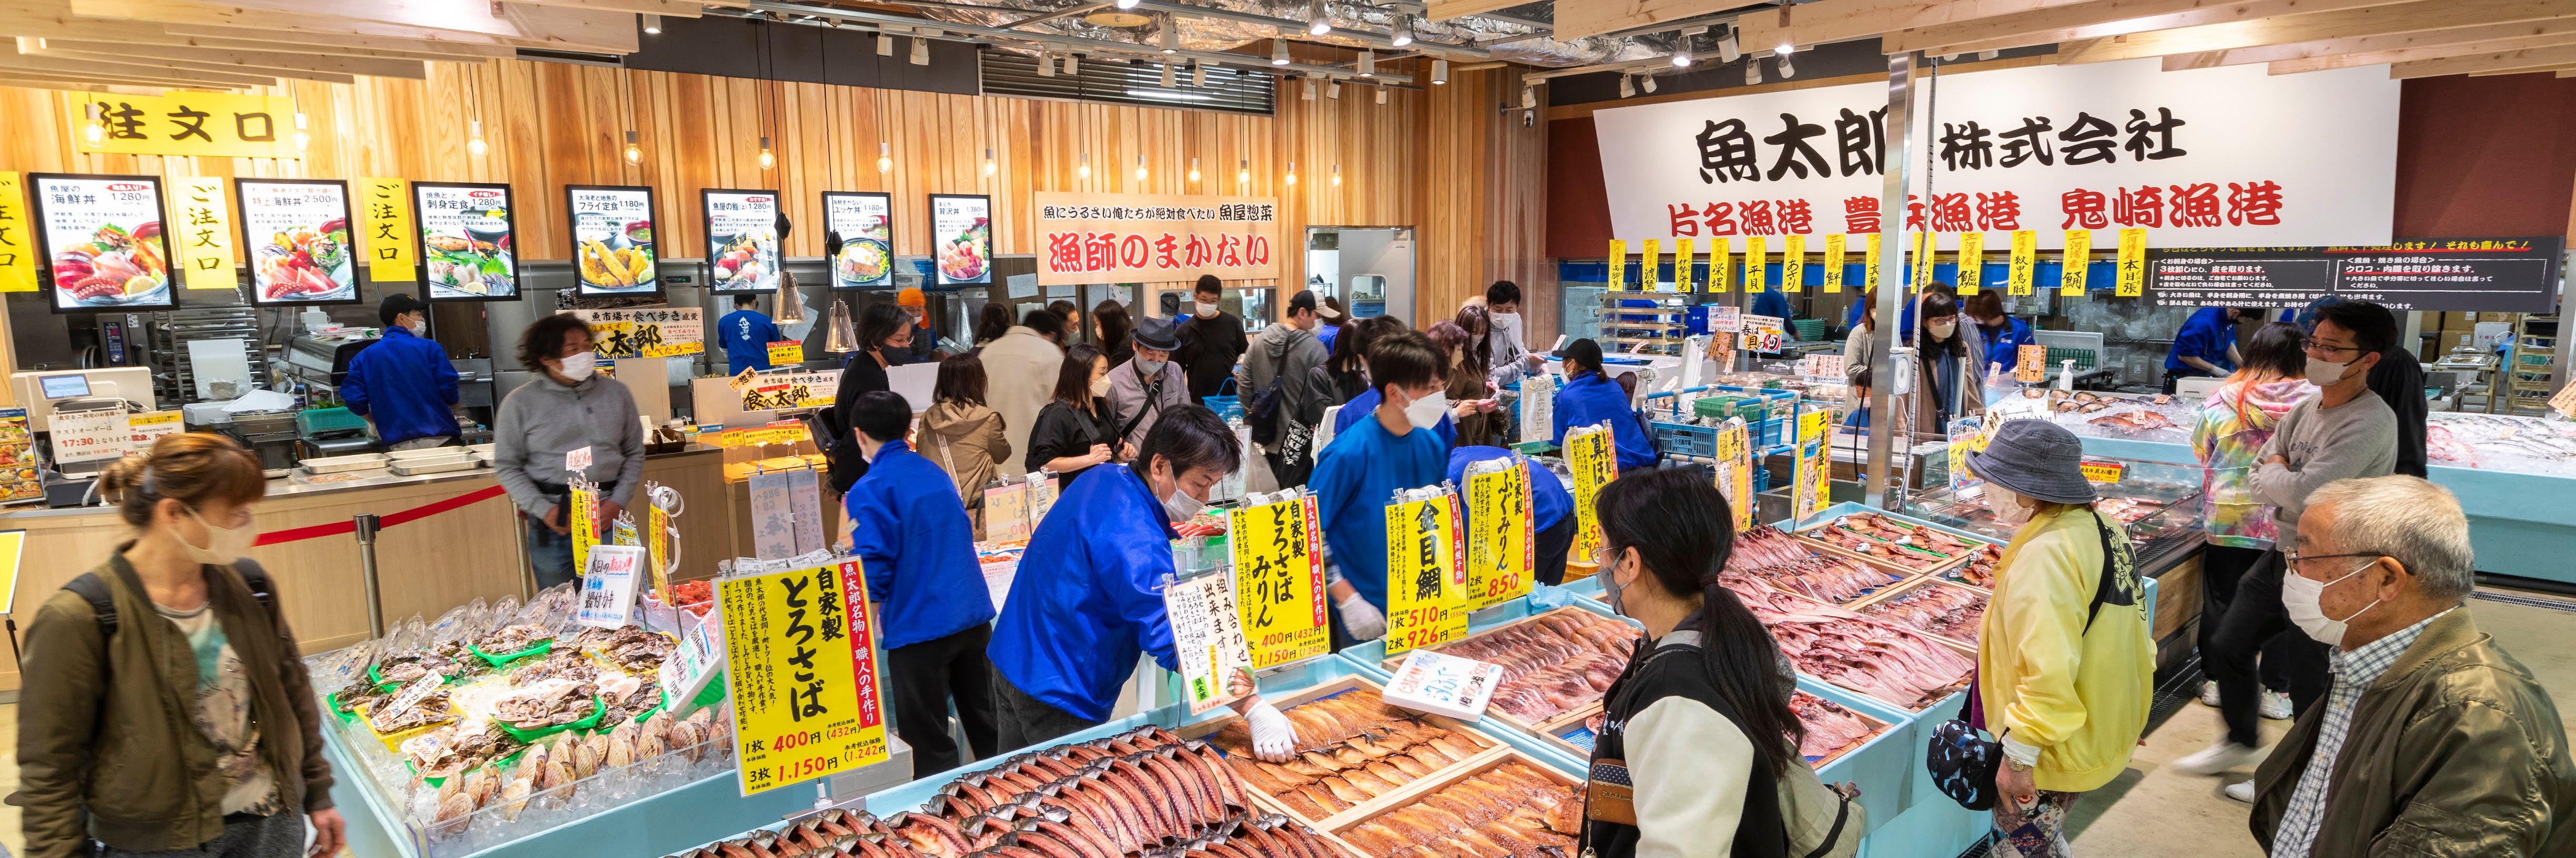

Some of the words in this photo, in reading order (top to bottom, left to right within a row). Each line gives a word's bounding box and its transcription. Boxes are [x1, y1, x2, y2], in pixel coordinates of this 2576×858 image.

[98, 101, 275, 142] 注文口
[1696, 105, 1889, 184] 魚太郎
[1939, 107, 2187, 171] 株式会社
[52, 194, 97, 205] 海鮮丼
[427, 200, 469, 209] 刺身定食
[579, 202, 618, 211] フライ定食
[1043, 206, 1215, 221] 魚にうるさい俺たちが絶対食べたい
[1219, 203, 1273, 222] 魚屋惣菜
[1668, 197, 1812, 237] 片名漁港
[2061, 180, 2284, 230] 鬼崎漁港
[190, 186, 221, 270] ご注文口
[374, 184, 400, 260] ご注文口
[1048, 232, 1269, 272] 漁師のまかない
[1829, 235, 1842, 270] 三河湾産
[1962, 233, 1977, 266] 三河湾産
[2067, 232, 2086, 270] 三河湾産
[2124, 228, 2140, 260] 三河湾産
[2446, 241, 2529, 250] それも喜んで!
[1711, 262, 1725, 290] 栄螺
[1748, 265, 1762, 290] 平貝
[1786, 258, 1799, 291] あさり
[2123, 259, 2139, 294] 本目張
[1741, 324, 1759, 336] 春は
[1747, 334, 1778, 350] 貝の旬
[743, 385, 810, 410] 食べ太郎
[55, 425, 113, 434] ラストオーダーは
[58, 411, 121, 421] 食堂をご利用のお客様へ
[1602, 431, 1611, 475] 自家製
[1514, 466, 1523, 516] 自家製
[1290, 501, 1306, 558] 自家製
[1496, 472, 1513, 571] ふぐみりん
[1580, 532, 1589, 540] 1枚
[1415, 500, 1442, 602] 金目鯛
[1448, 494, 1464, 581] お買い得!高級干物
[1580, 540, 1589, 550] 2枚
[1271, 504, 1294, 605] とろさば
[1306, 499, 1323, 625] 魚太郎名物!職人の手作り
[1252, 555, 1273, 629] みりん
[1468, 591, 1486, 601] 本体価格
[1469, 577, 1483, 587] 2枚
[1488, 572, 1519, 598] 850
[1506, 588, 1523, 600] (918円)
[816, 567, 845, 642] 自家製
[1390, 608, 1409, 618] 本体価格
[1390, 617, 1405, 629] 1枚
[1408, 606, 1447, 628] 510円
[1203, 583, 1228, 666] 出来ます!
[1216, 579, 1248, 662] 組み合わせ
[780, 575, 828, 722] とろさば
[844, 563, 875, 724] 魚太郎名物!職人の手作り
[1262, 632, 1292, 648] 400円
[1294, 625, 1325, 641] (432円)
[1299, 637, 1325, 648] 参考税込価格
[1389, 636, 1405, 649] 2枚
[1407, 625, 1448, 648] 926円
[827, 718, 856, 729] 参考税込価格
[745, 739, 766, 754] 1枚
[773, 731, 822, 753] 400円
[826, 723, 861, 741] (432円)
[844, 737, 882, 751] 参考税込価格
[746, 753, 767, 763] 本体価格
[749, 767, 772, 783] 3枚
[751, 781, 772, 791] 本体価格
